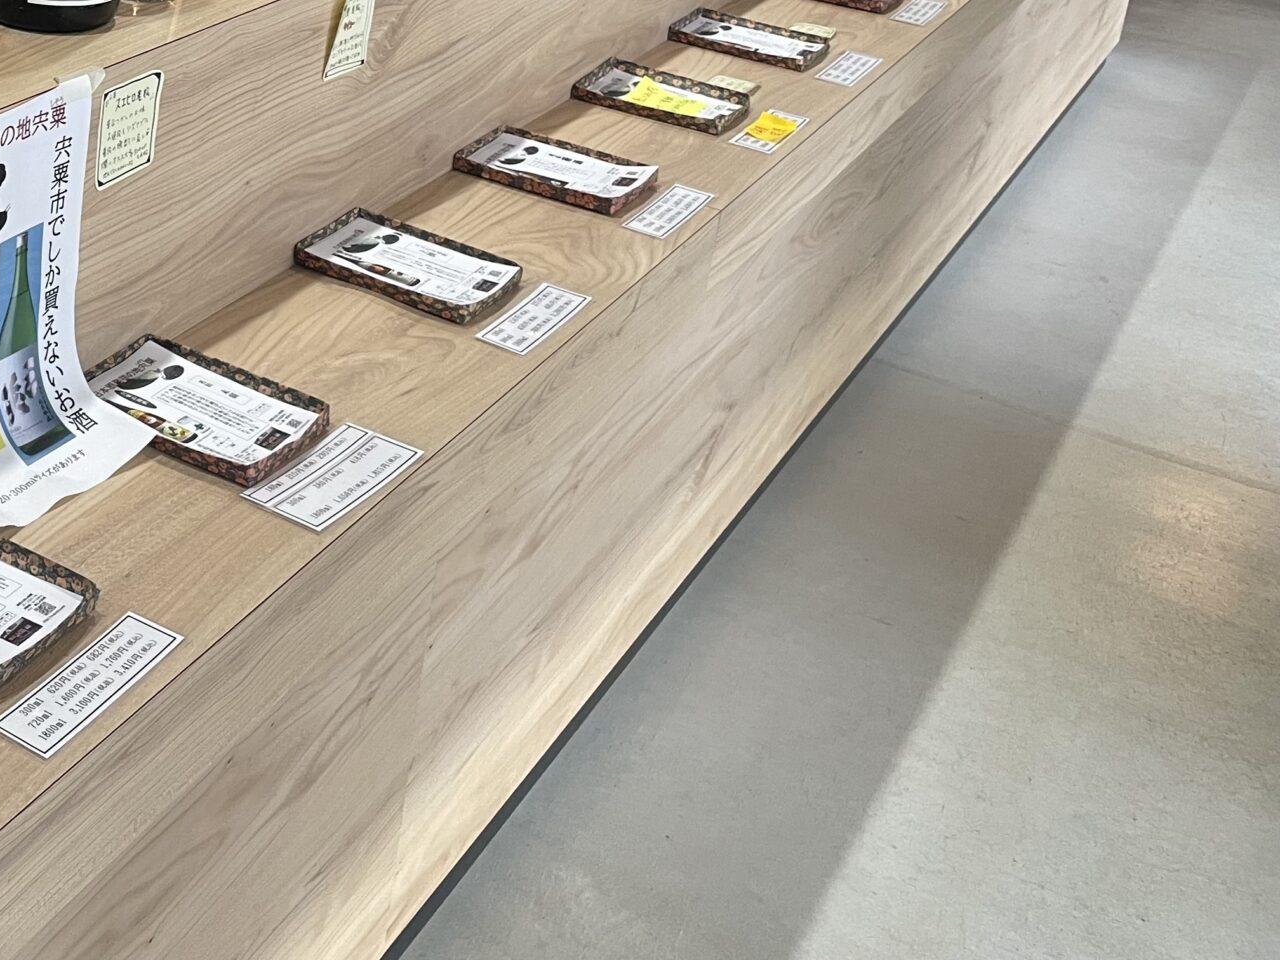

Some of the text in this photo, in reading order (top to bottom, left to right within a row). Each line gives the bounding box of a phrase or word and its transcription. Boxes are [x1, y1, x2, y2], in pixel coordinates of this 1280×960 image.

[41, 135, 99, 435] 宍粟市でしか買えないお酒
[19, 630, 125, 718] 300ml 620円(税抜) 682円(税込)
[27, 632, 145, 730] 720ml 1,600円(税抜) 1,760円(税込)
[38, 639, 158, 741] 1800ml 3,100円(税抜) 3,410円(税込)
